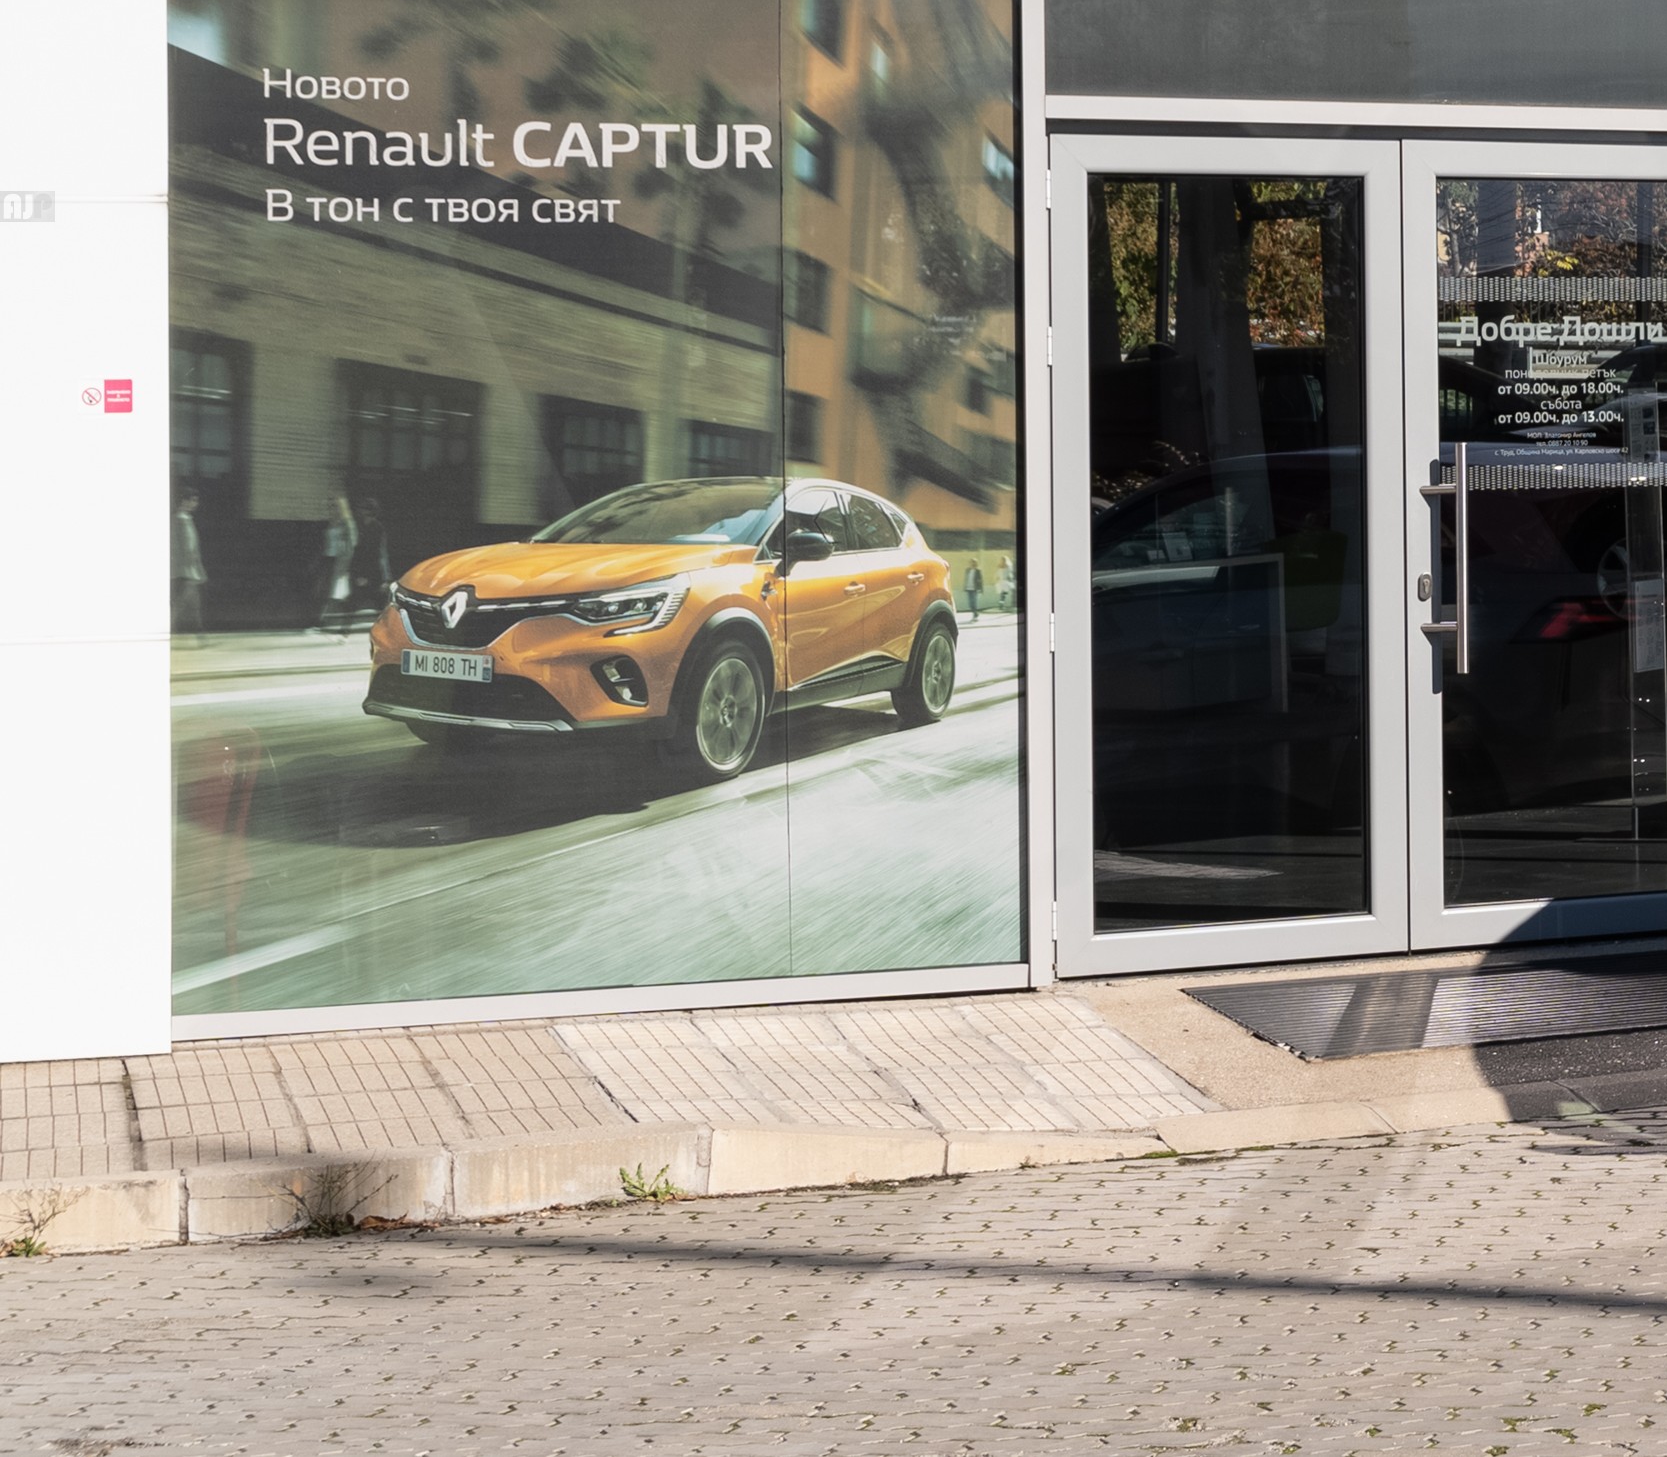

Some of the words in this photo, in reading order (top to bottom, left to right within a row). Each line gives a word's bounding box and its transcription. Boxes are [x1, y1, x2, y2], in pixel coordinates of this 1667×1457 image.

[263, 68, 410, 100] Новото
[264, 118, 494, 168] Renault
[513, 121, 773, 169] CAPTUR
[266, 188, 294, 222] В
[306, 197, 380, 222] тон
[393, 198, 414, 222] с
[425, 198, 519, 223] твоя
[532, 199, 621, 223] свят
[1456, 315, 1551, 347] Добре
[1558, 315, 1664, 346] Дошли
[1498, 385, 1512, 394] от
[1514, 383, 1559, 395] 09.00ч.
[1561, 385, 1578, 397] до
[1581, 383, 1624, 395] 18.00ч.
[1541, 398, 1582, 410] събота
[1498, 414, 1512, 423] от
[1514, 412, 1559, 423] 09.00ч.
[1561, 414, 1578, 425] до
[1583, 411, 1624, 423] 13.00ч.
[415, 655, 428, 672] MI
[432, 656, 455, 674] 808
[461, 658, 477, 676] TH
